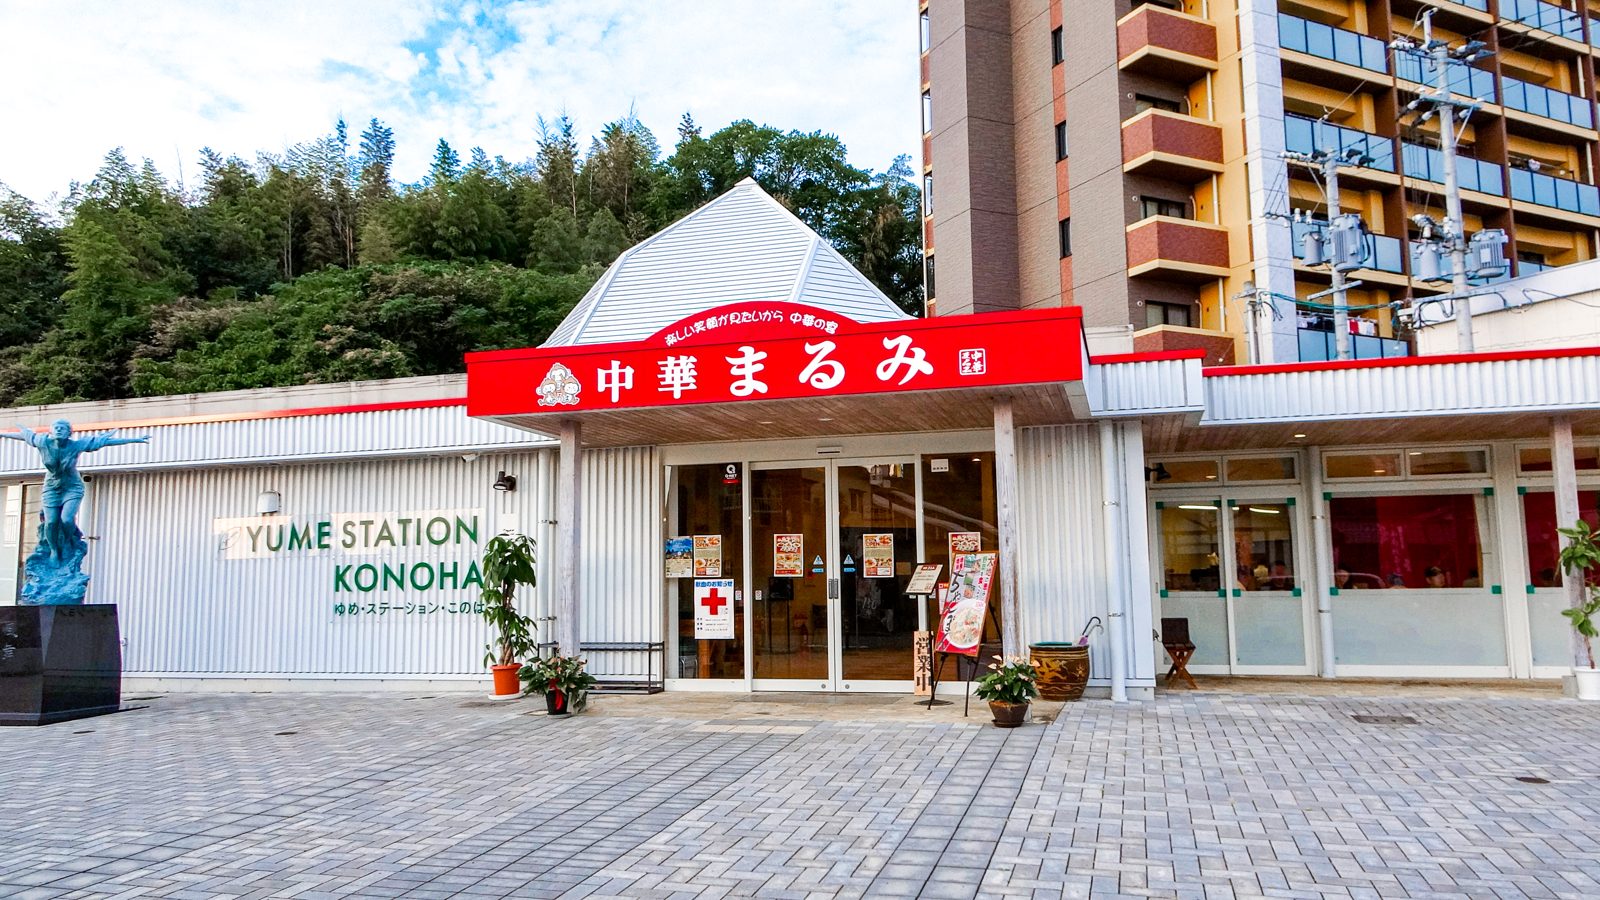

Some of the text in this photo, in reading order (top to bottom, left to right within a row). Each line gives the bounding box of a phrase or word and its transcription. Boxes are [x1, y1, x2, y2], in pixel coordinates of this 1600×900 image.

[664, 310, 784, 346] 楽しい笑顔が見たいから
[246, 515, 478, 552] YUME STATION
[334, 560, 484, 593] KONOHA
[334, 601, 486, 617] ゆめ・ステーション・このは
[915, 637, 932, 691] 営業中
